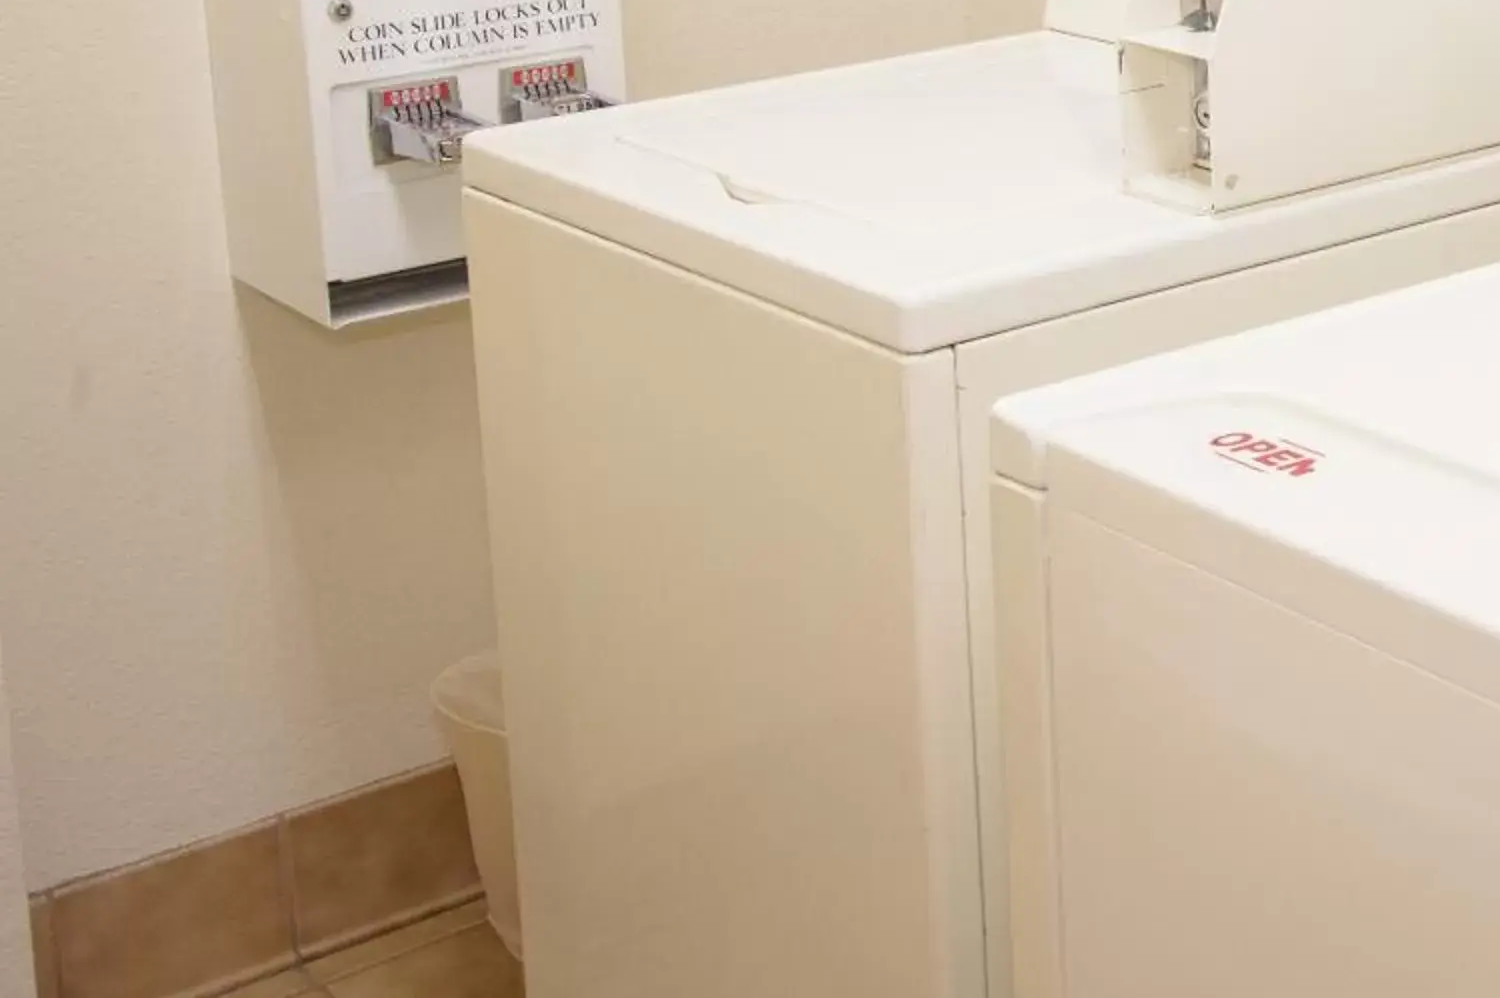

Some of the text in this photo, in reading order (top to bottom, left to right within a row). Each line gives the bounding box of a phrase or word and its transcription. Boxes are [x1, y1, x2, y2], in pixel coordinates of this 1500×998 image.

[338, 44, 406, 66] WHEN
[413, 25, 507, 53] COLUMN
[512, 22, 530, 40] IS
[536, 11, 600, 37] EMPTY
[348, 22, 404, 44] COIN
[410, 11, 467, 35] SLIDE
[473, 2, 542, 26] LOCKS
[1209, 432, 1317, 477] OPEN
